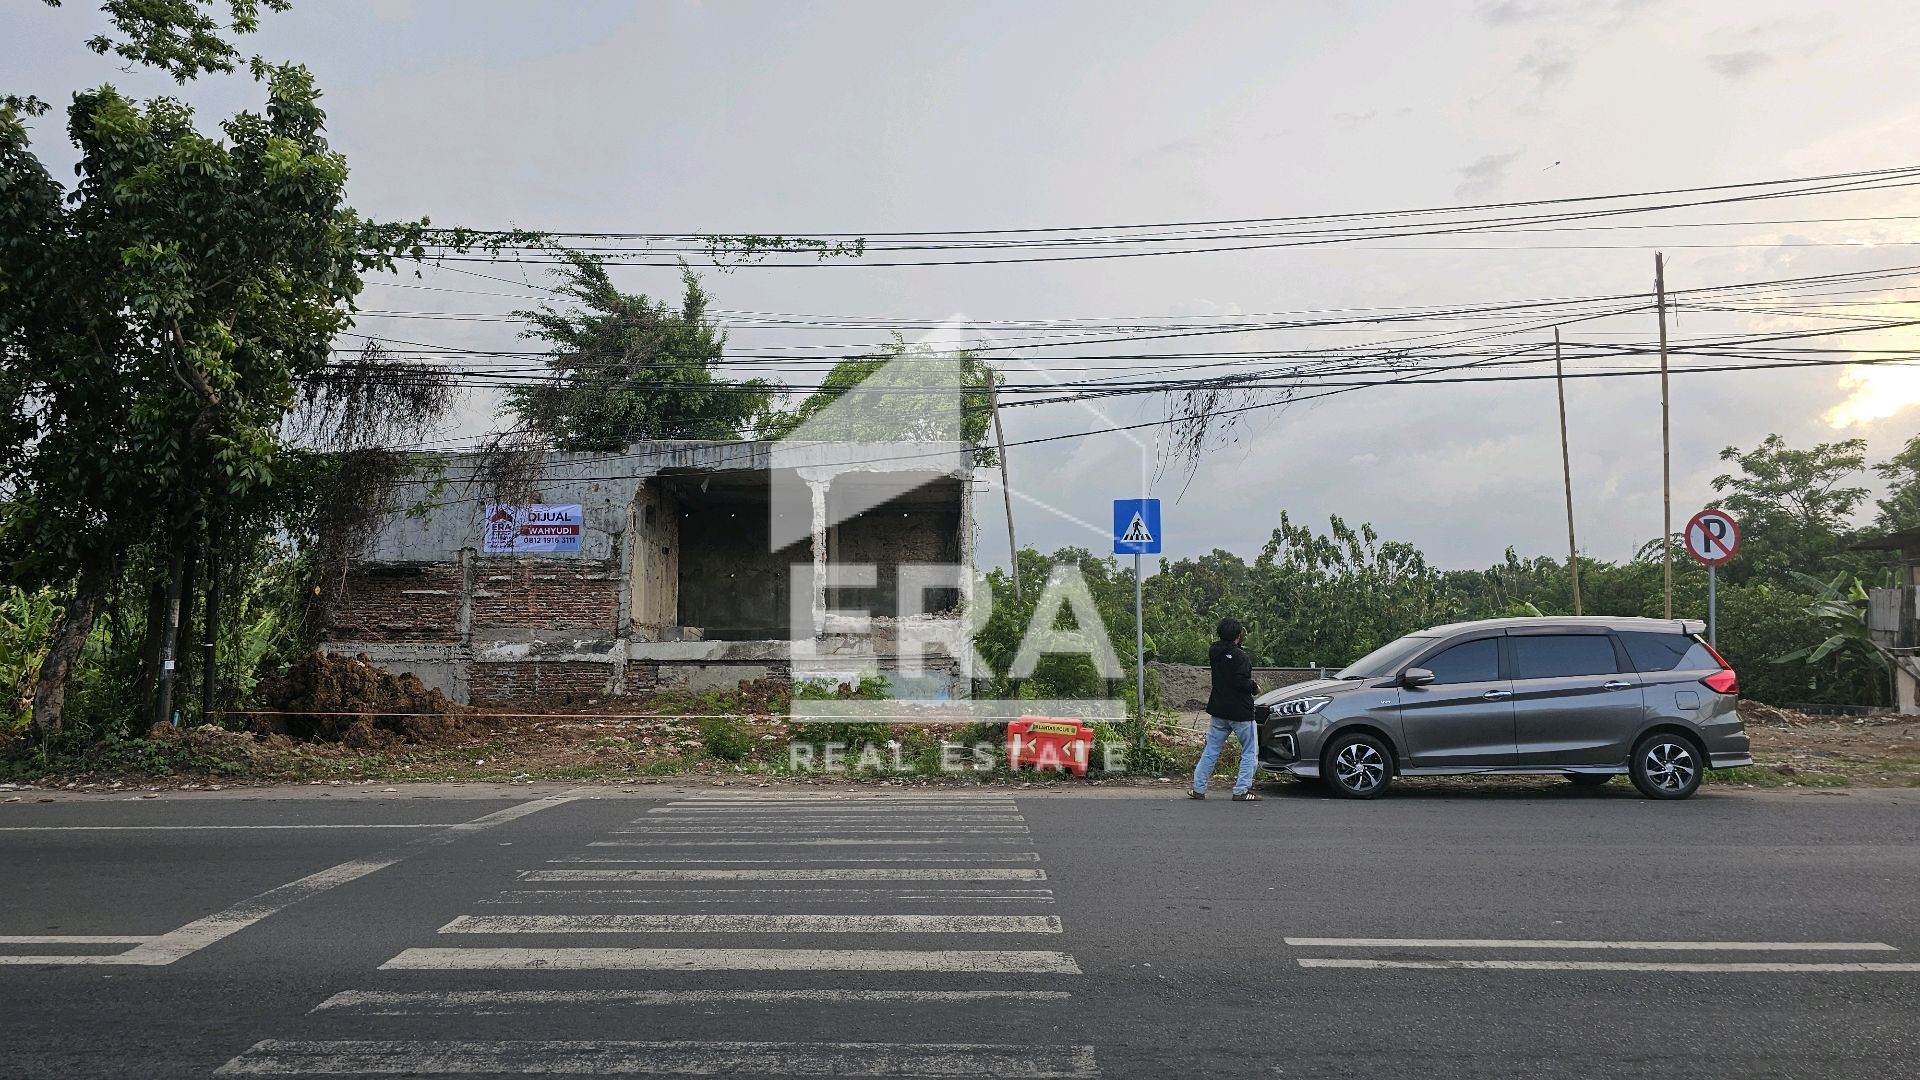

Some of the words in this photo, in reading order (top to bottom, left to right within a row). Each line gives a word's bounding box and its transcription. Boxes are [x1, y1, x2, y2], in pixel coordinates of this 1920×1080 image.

[528, 512, 572, 522] DIJUAL
[491, 523, 512, 531] ERA
[528, 527, 572, 535] WAHYUDI
[1703, 518, 1727, 553] P
